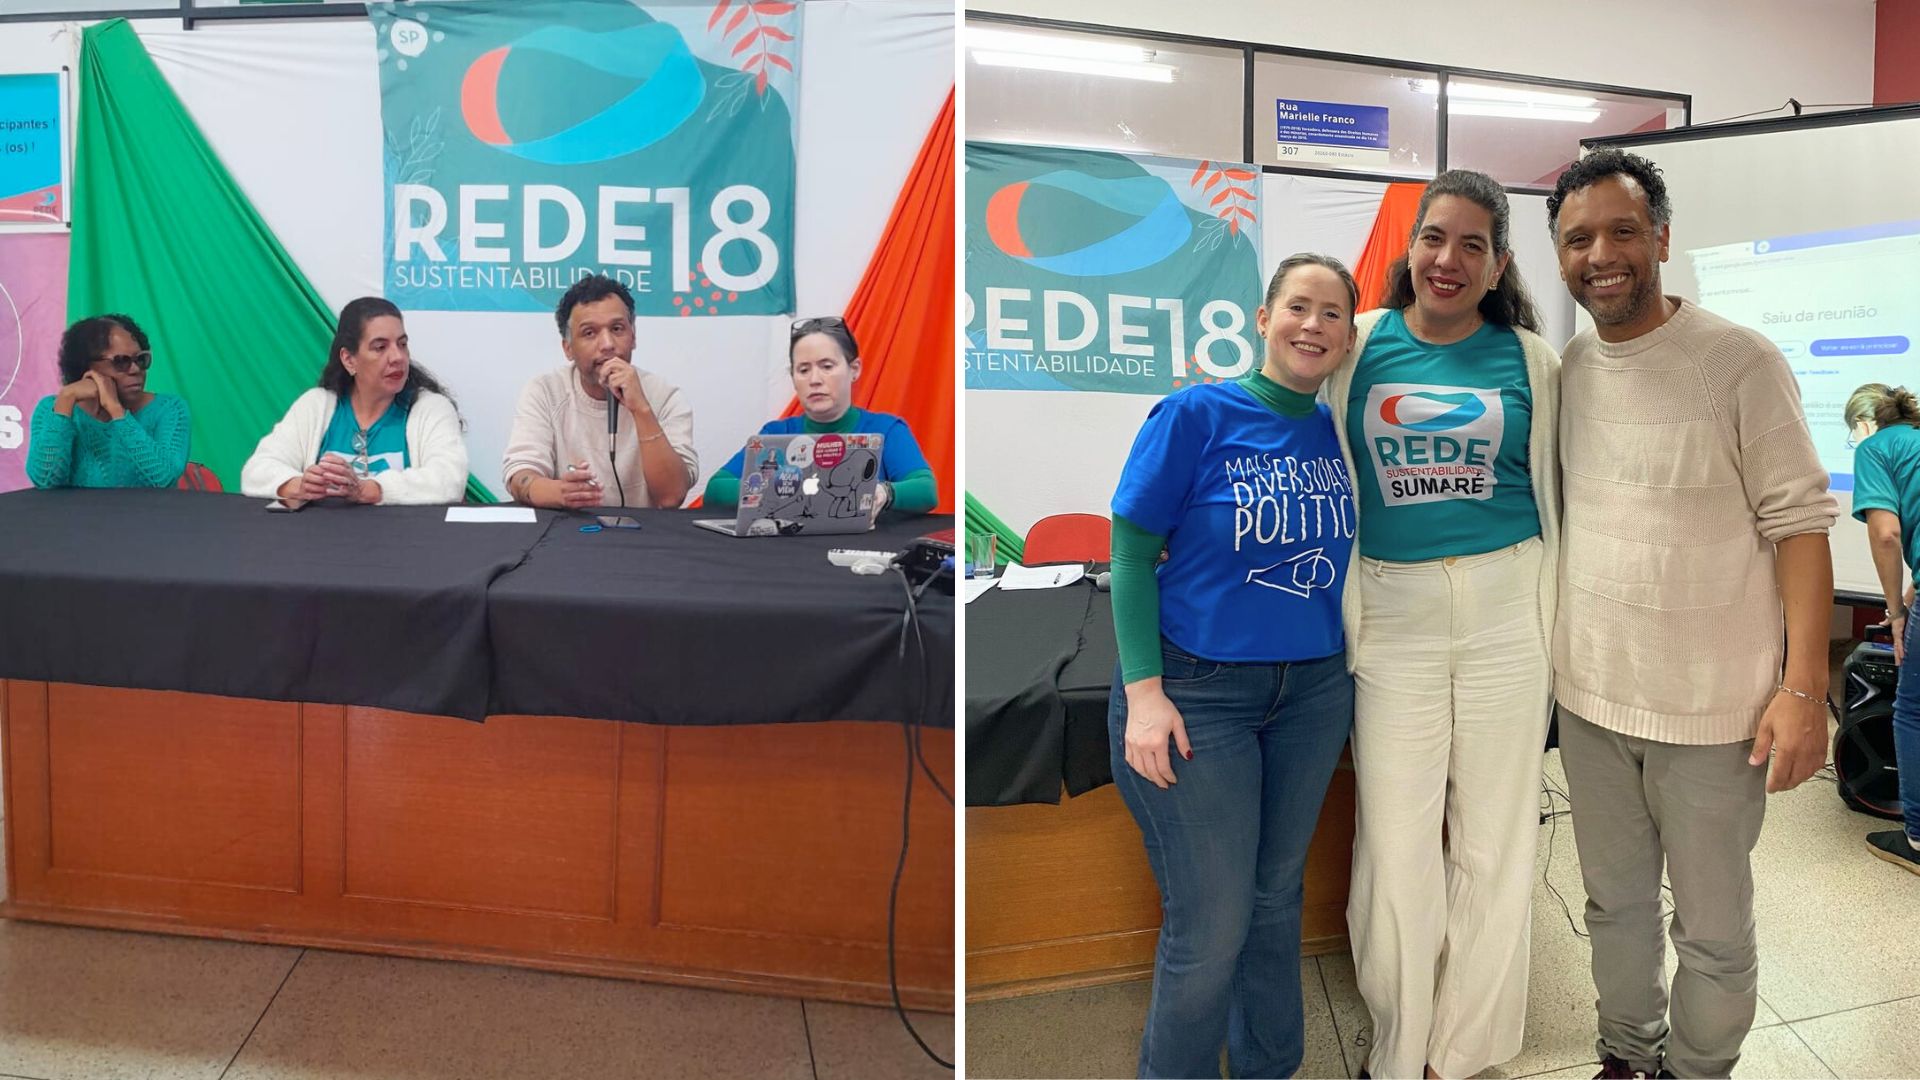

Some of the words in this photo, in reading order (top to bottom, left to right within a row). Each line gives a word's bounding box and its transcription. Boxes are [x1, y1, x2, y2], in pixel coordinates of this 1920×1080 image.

[399, 30, 420, 44] SP
[1280, 102, 1298, 111] Rua
[1280, 111, 1320, 122] Marielle
[1323, 114, 1355, 124] Franco
[5, 143, 28, 155] (os)
[1282, 146, 1299, 155] 307
[1762, 310, 1792, 325] Saiu
[1795, 308, 1814, 323] da
[1818, 304, 1878, 321] reunião
[1374, 436, 1491, 467] REDE
[1226, 453, 1271, 484] MAIS
[1386, 465, 1485, 479] SUSTENTABILIDADE
[1391, 473, 1485, 498] SUMARÉ
[1234, 494, 1355, 551] POLÍTIC
